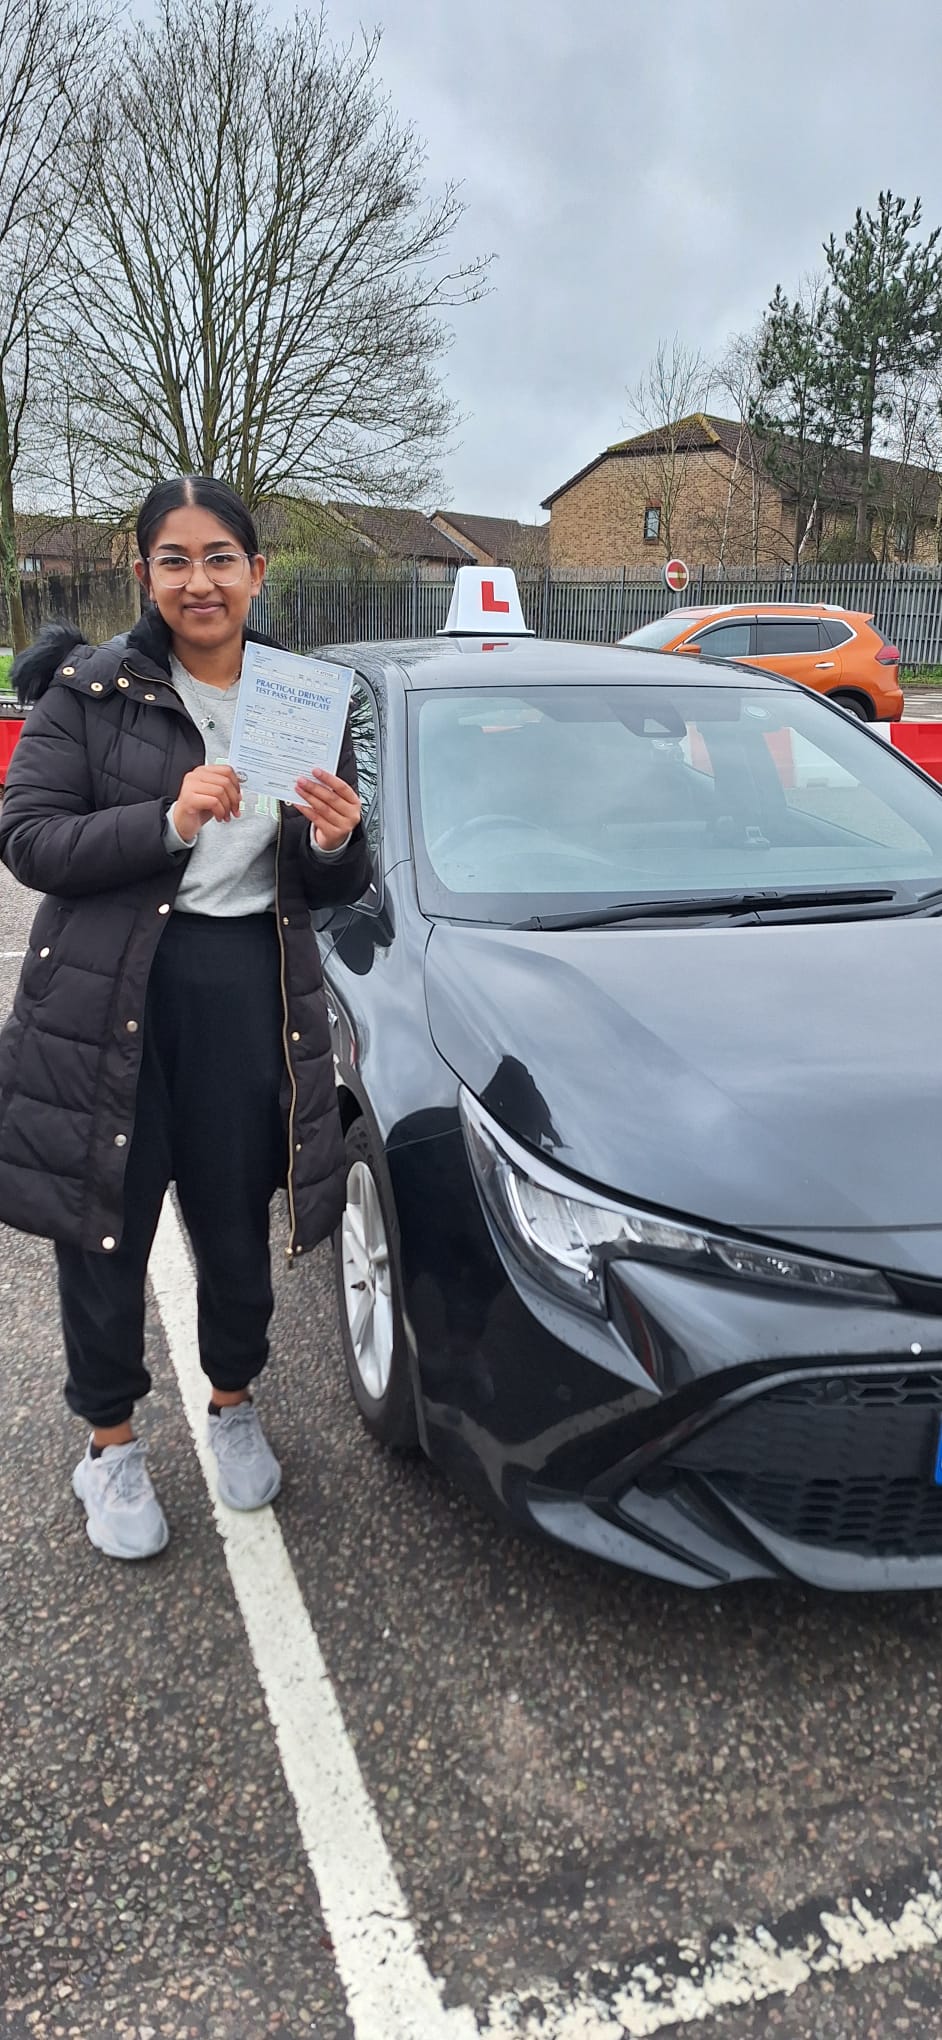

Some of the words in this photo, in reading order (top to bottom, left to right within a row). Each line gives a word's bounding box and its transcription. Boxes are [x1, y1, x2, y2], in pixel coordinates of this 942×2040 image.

[481, 581, 510, 613] L
[256, 679, 296, 695] PRACTICAL
[298, 690, 331, 705] DRIVING
[256, 686, 270, 696] TEST
[271, 690, 287, 700] PASS
[289, 695, 330, 711] CERTIFICATE
